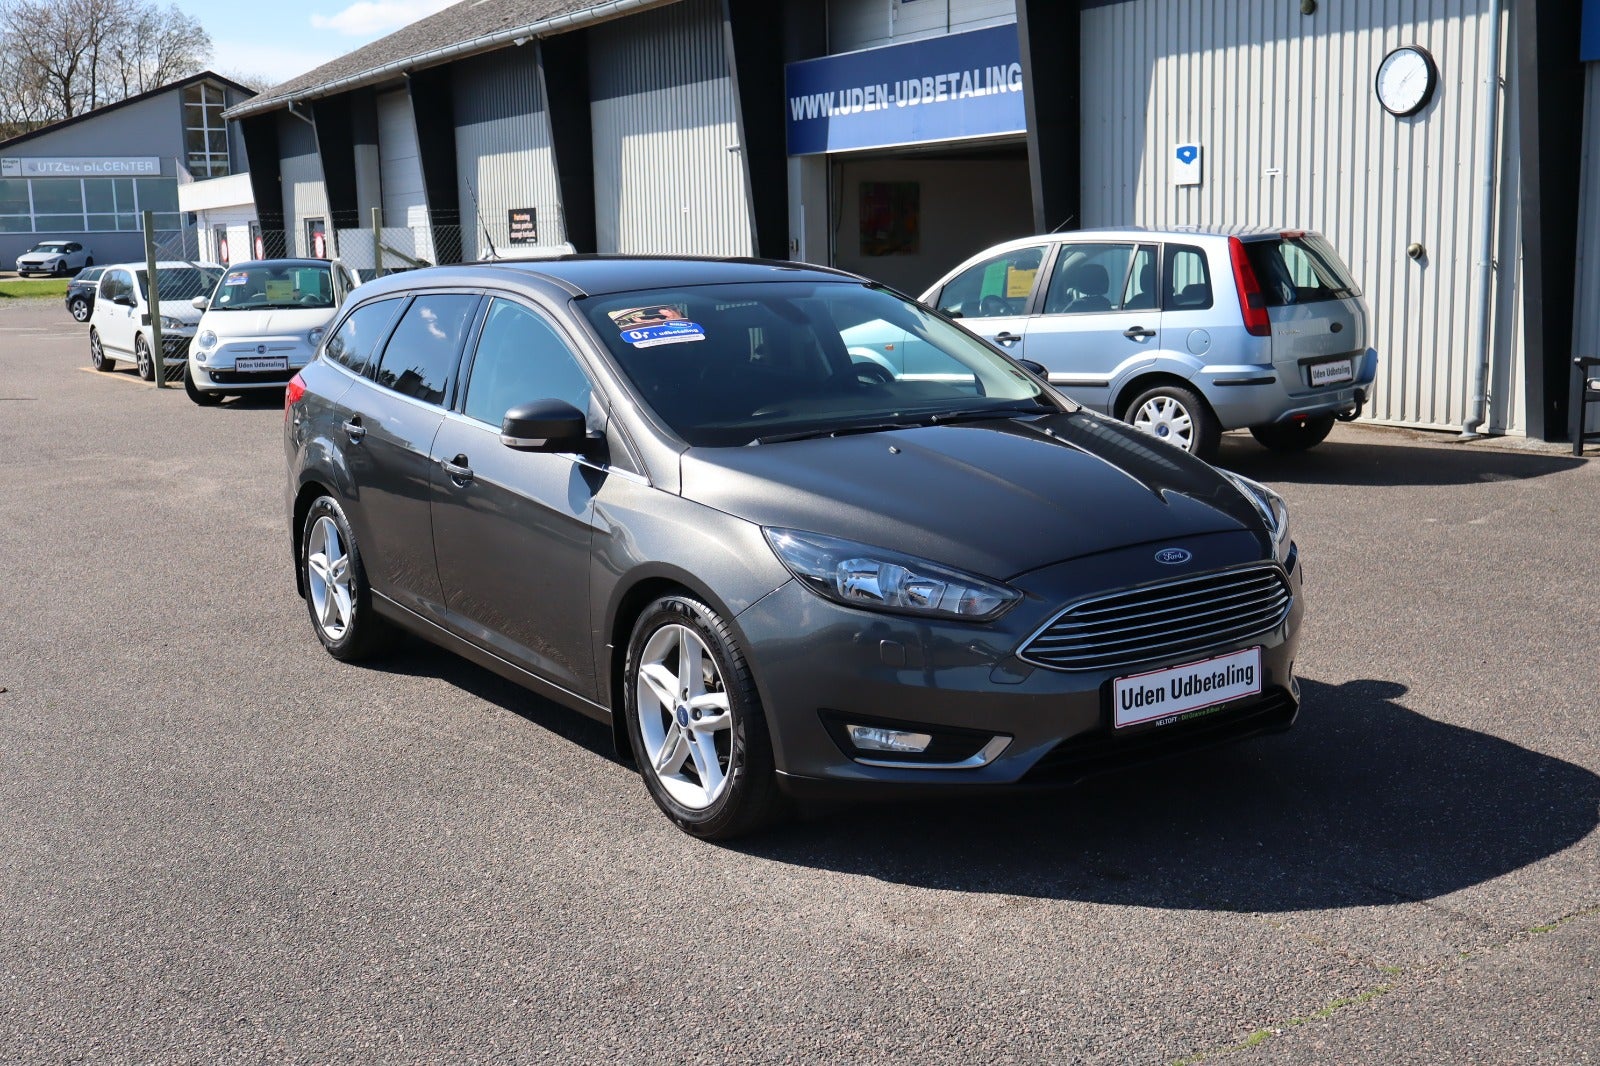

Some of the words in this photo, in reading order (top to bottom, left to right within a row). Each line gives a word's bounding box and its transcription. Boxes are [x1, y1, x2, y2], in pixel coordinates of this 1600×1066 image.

[790, 63, 1022, 121] WWW.UDEN-UDBETALING
[84, 161, 153, 172] BILCENTER
[1313, 369, 1325, 379] Uden
[1326, 366, 1350, 377] Udbetaling
[1121, 685, 1165, 711] Uden
[1171, 664, 1254, 700] Udbetaling
[1155, 716, 1177, 727] NELTOFT
